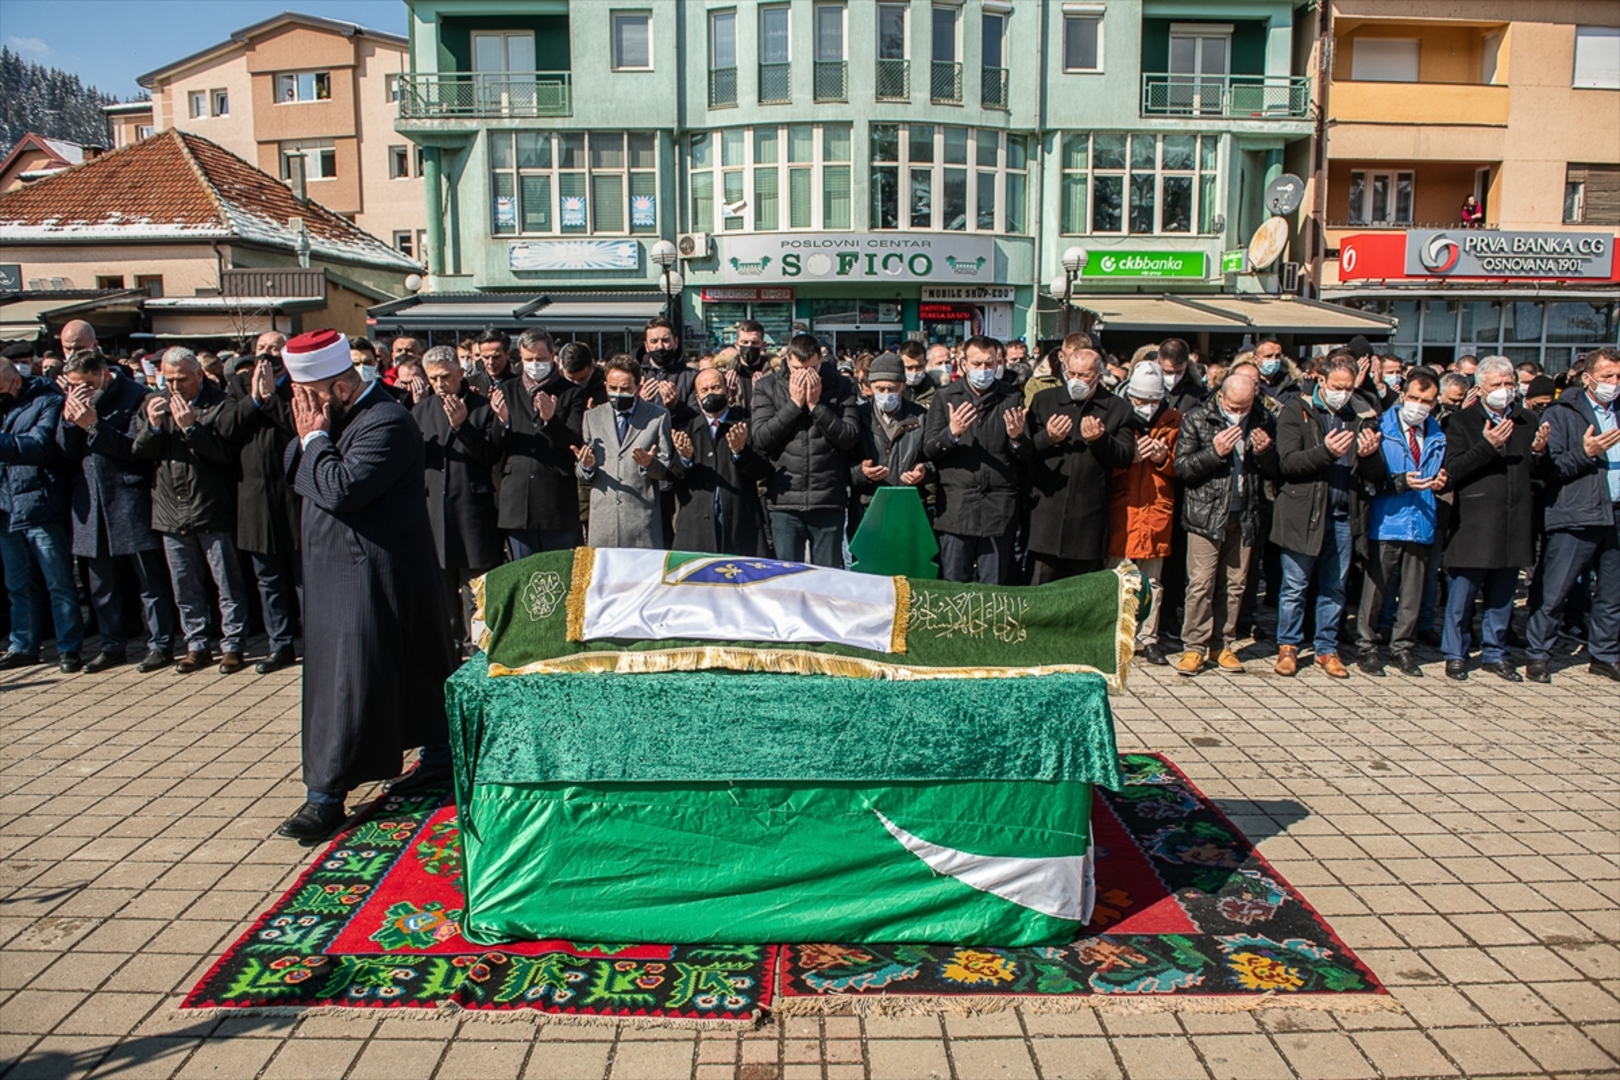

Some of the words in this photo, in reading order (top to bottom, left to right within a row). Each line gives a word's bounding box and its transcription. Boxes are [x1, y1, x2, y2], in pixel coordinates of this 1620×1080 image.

[780, 239, 860, 248] POSLOVNI
[866, 239, 932, 248] CENTAR
[1465, 235, 1508, 252] PRVA
[1512, 236, 1574, 253] BANKA
[1579, 237, 1605, 254] CG
[1482, 257, 1555, 271] OSNOVANA
[761, 288, 791, 299] SHOP
